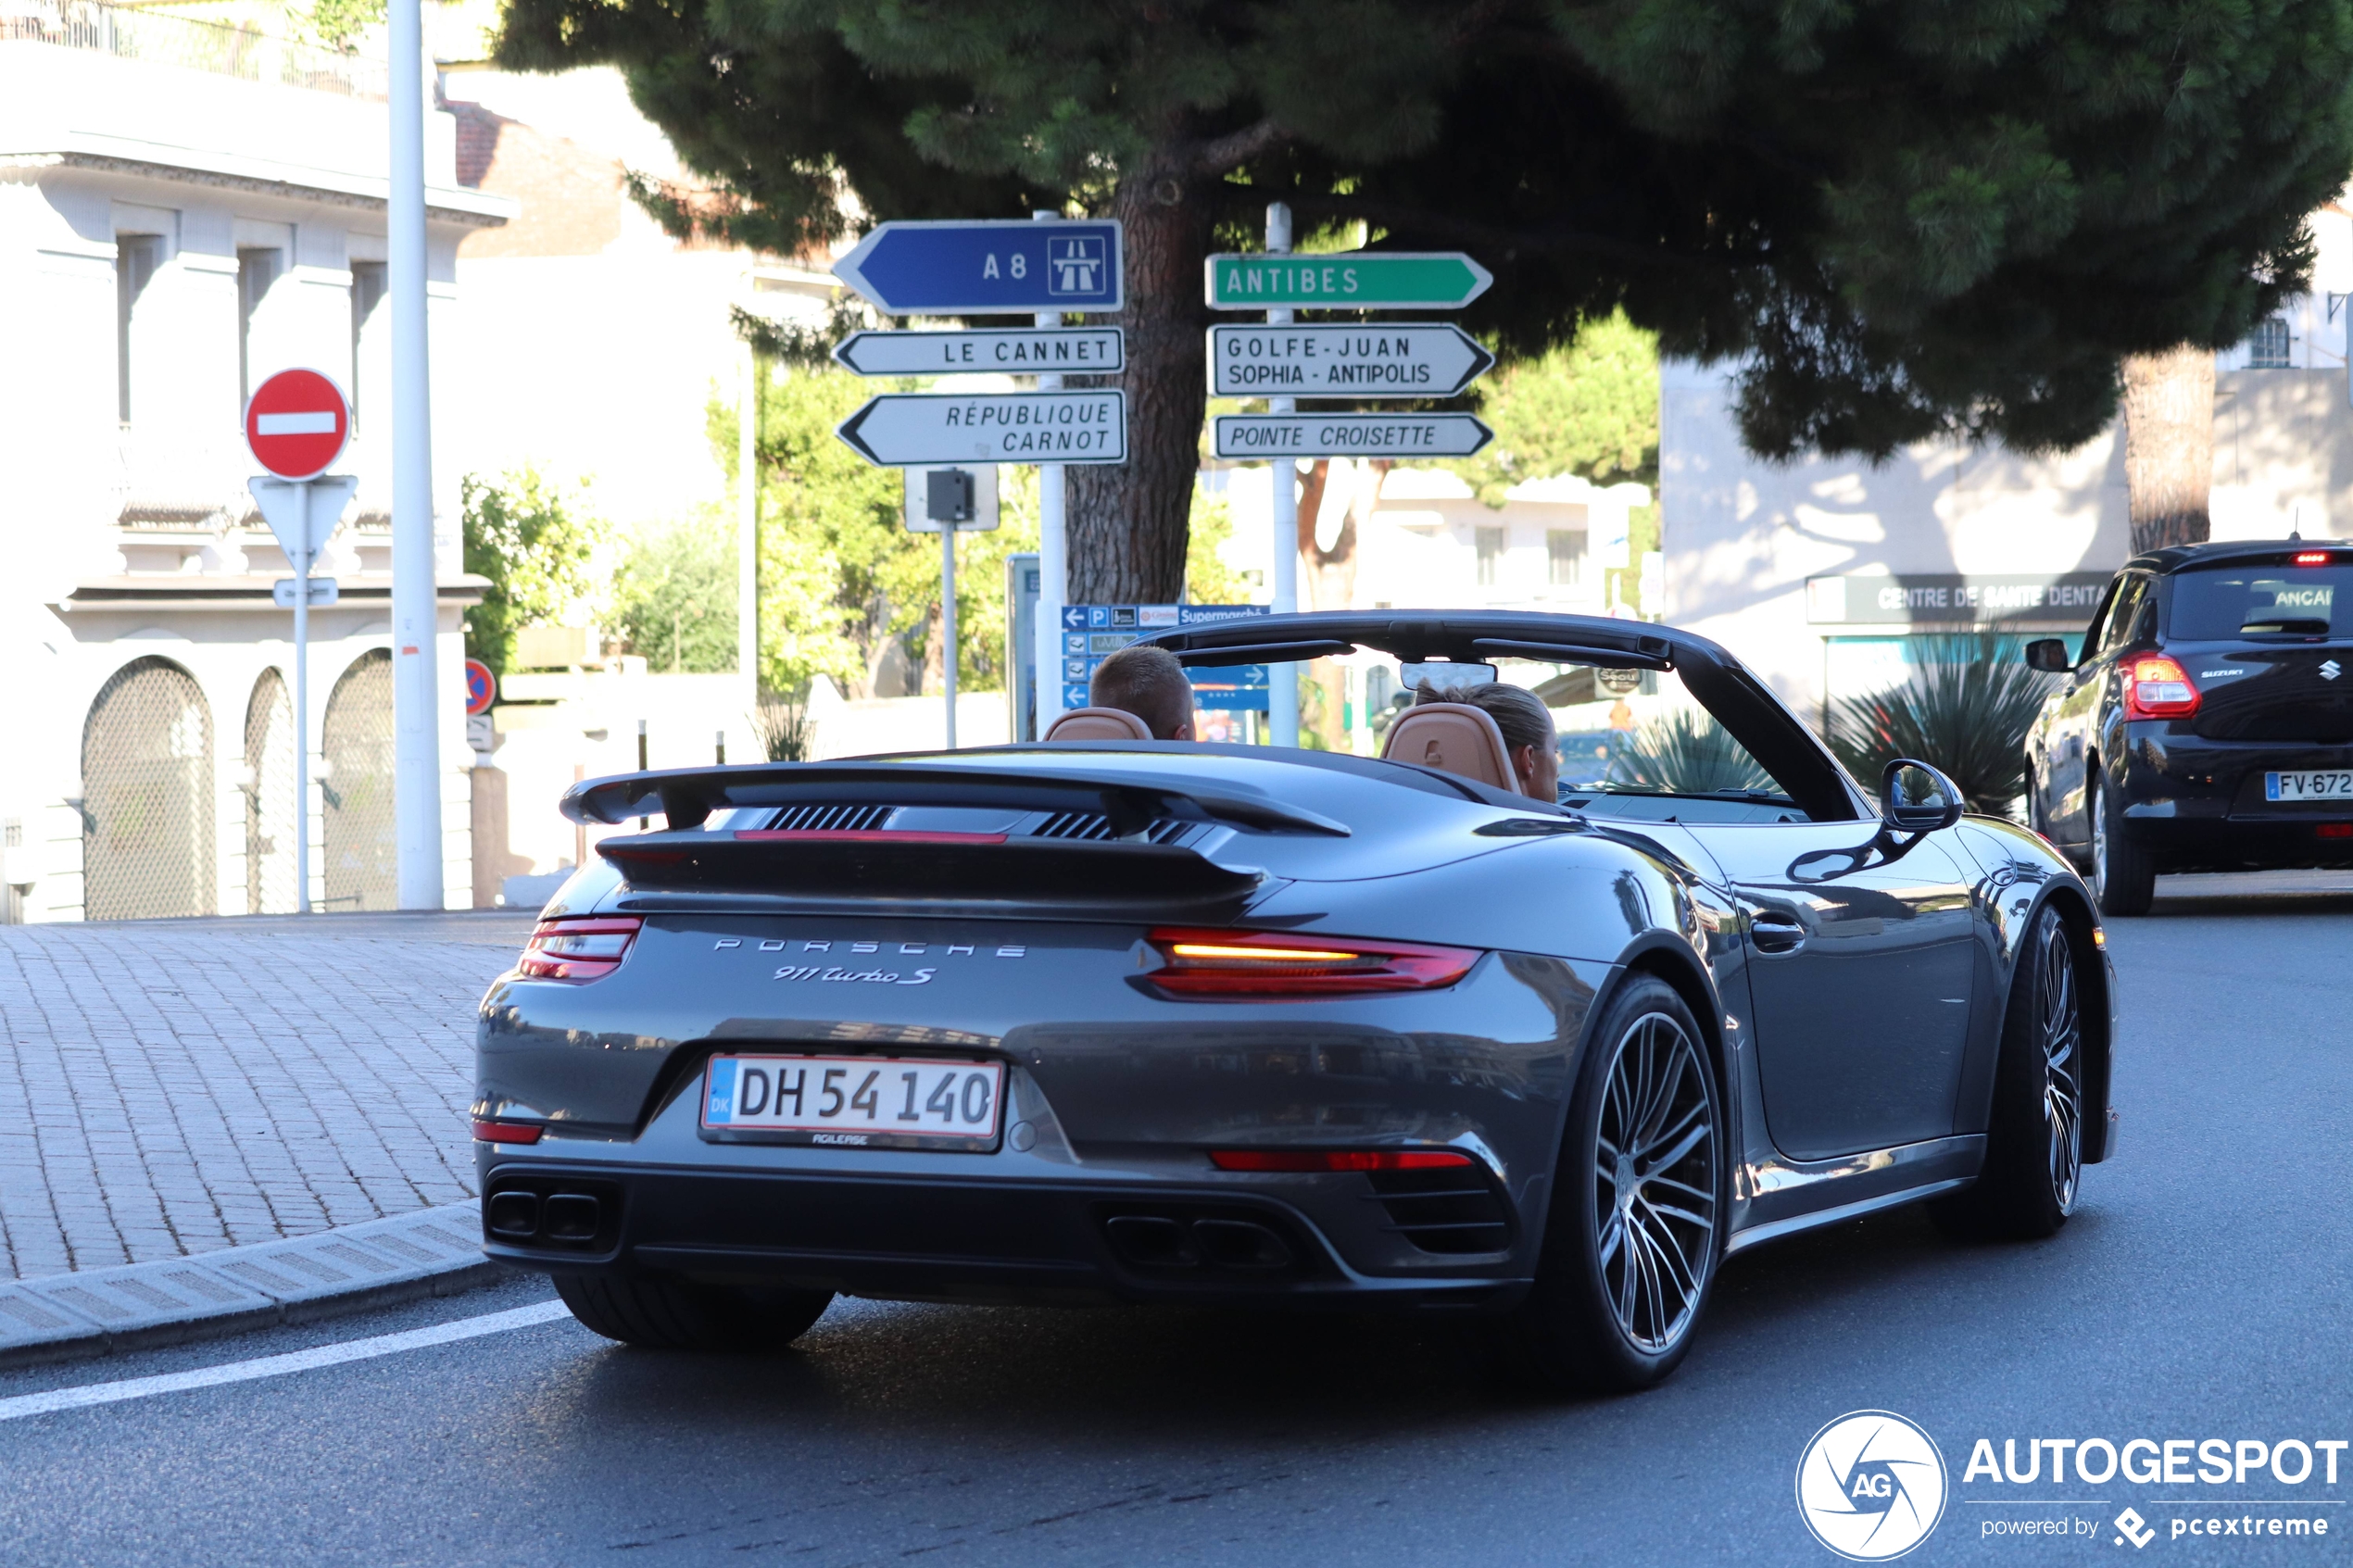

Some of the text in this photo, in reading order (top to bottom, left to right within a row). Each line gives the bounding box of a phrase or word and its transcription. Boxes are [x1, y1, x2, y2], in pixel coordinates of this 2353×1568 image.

[983, 253, 1027, 279] A 8
[1227, 268, 1359, 294] ANTIBES
[945, 340, 1107, 362] LE CANNET
[1229, 365, 1303, 385] SOPHIA
[1327, 363, 1430, 383] ANTIPOLIS
[947, 402, 1110, 426] RÉPUBLIQUE
[1003, 431, 1109, 452] CARNOT
[1230, 425, 1436, 447] POINTE CROISETTE
[1878, 586, 1947, 609] CENTRE
[1955, 586, 1979, 608] DE
[2049, 586, 2107, 607] DENTA
[2201, 669, 2244, 679] SUZUKI
[2280, 773, 2352, 795] FV-672
[714, 938, 1026, 958] PORSCHE
[774, 966, 937, 985] 911 turbo S
[711, 1097, 730, 1113] DK
[738, 1068, 990, 1124] DH 54 140
[812, 1133, 868, 1146] AGILEASE
